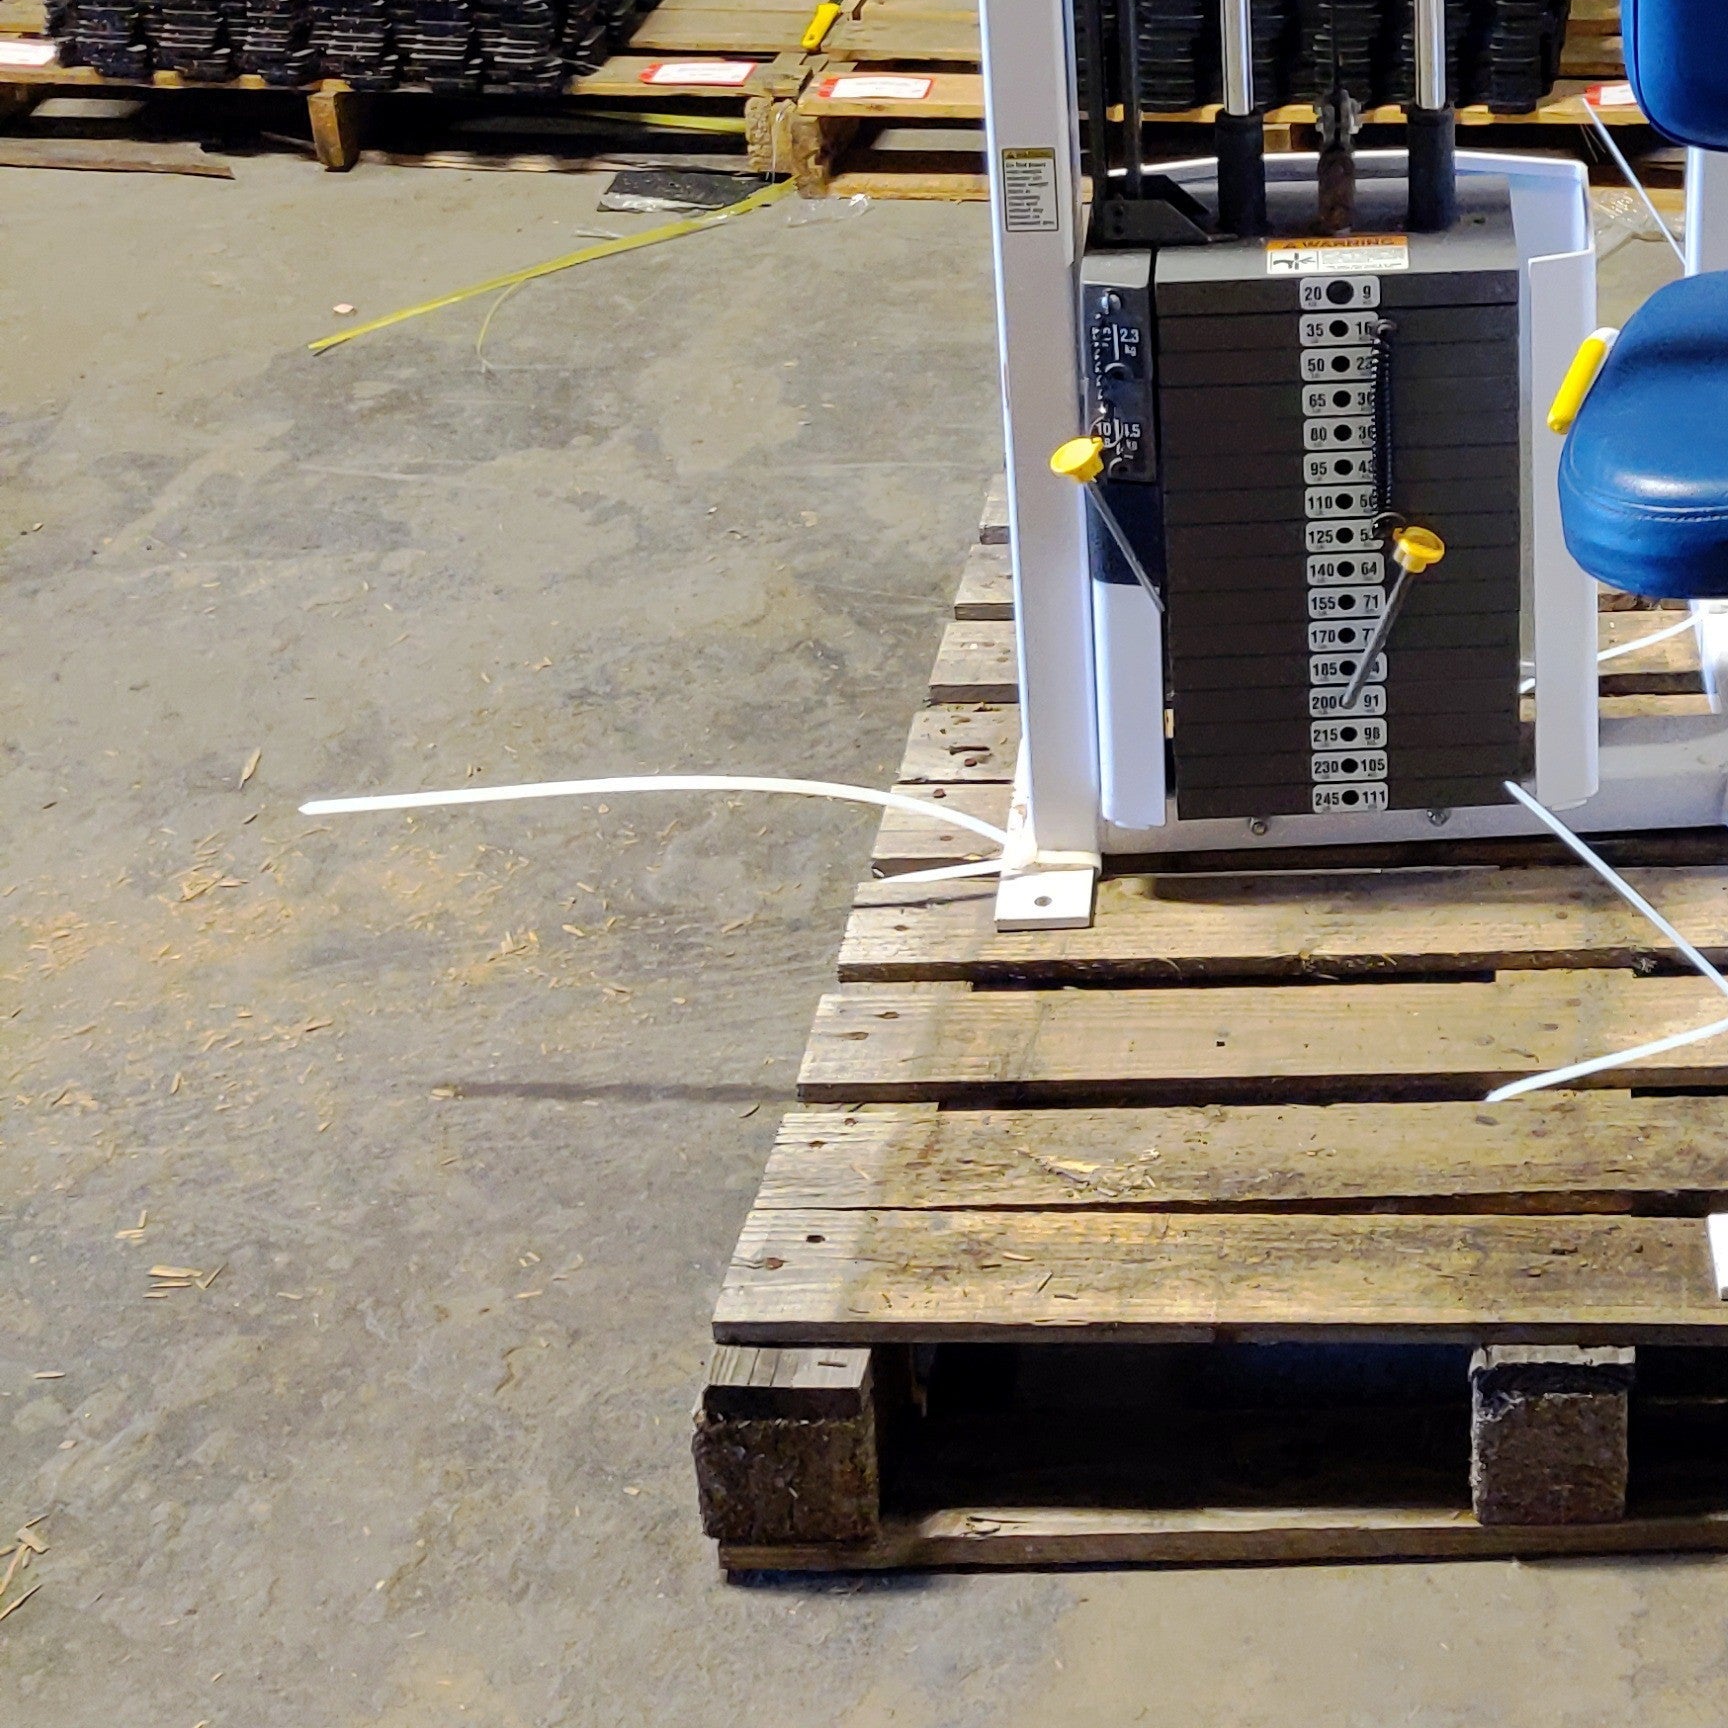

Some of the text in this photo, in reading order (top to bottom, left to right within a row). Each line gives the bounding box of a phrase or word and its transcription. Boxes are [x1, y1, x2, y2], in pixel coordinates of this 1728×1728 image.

[1304, 285, 1372, 301] 20 9
[1306, 323, 1324, 337] 35
[1307, 358, 1325, 372] 50
[1309, 393, 1327, 407] 65
[1310, 427, 1327, 442] 80
[1310, 462, 1328, 476] 95
[1308, 495, 1333, 510] 110
[1308, 528, 1372, 544] 125 5
[1310, 561, 1377, 578] 140 64
[1311, 594, 1379, 610] 155 71
[1311, 629, 1336, 643] 170
[1312, 694, 1379, 710] 200 91
[1313, 726, 1381, 742] 215 98
[1314, 758, 1386, 774] 230 105
[1315, 790, 1386, 806] 245 111
